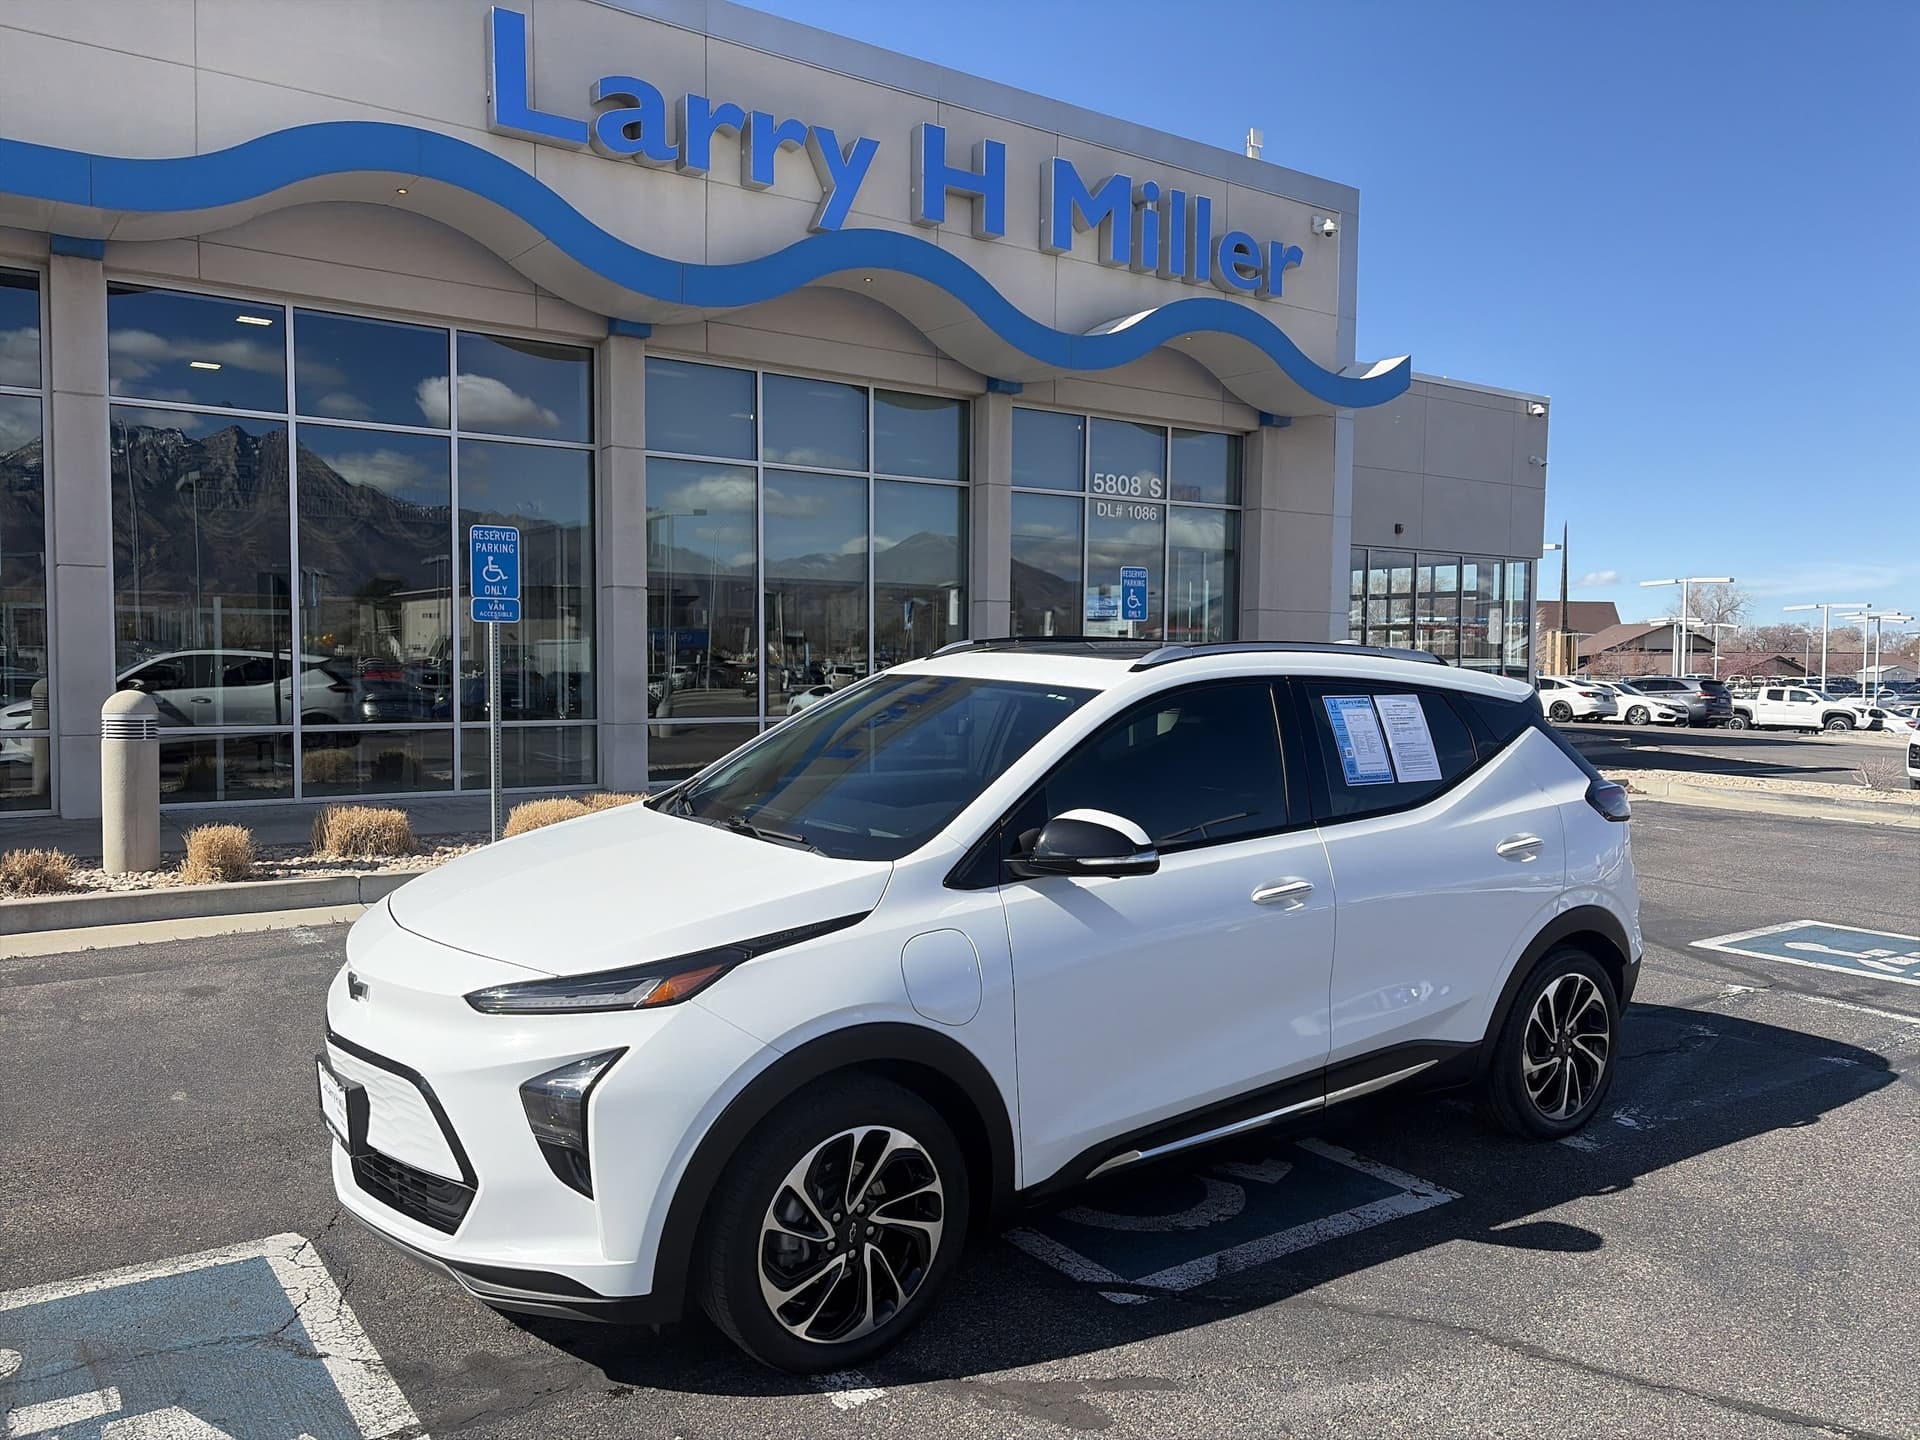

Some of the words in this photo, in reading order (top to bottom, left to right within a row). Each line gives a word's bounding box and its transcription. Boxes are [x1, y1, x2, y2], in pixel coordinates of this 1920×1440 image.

[488, 5, 880, 232] Larry
[913, 121, 1006, 239] H
[1041, 155, 1304, 299] Miller
[1093, 473, 1141, 496] 5808
[1150, 478, 1162, 498] S
[1097, 502, 1123, 518] DL#
[1127, 505, 1157, 520] 1086
[472, 530, 517, 541] RESERVED
[475, 542, 515, 553] PARKING
[1123, 579, 1145, 587] PARKING
[484, 585, 508, 595] ONLY
[487, 602, 505, 611] VAN
[479, 610, 513, 618] ACCESSIBLE
